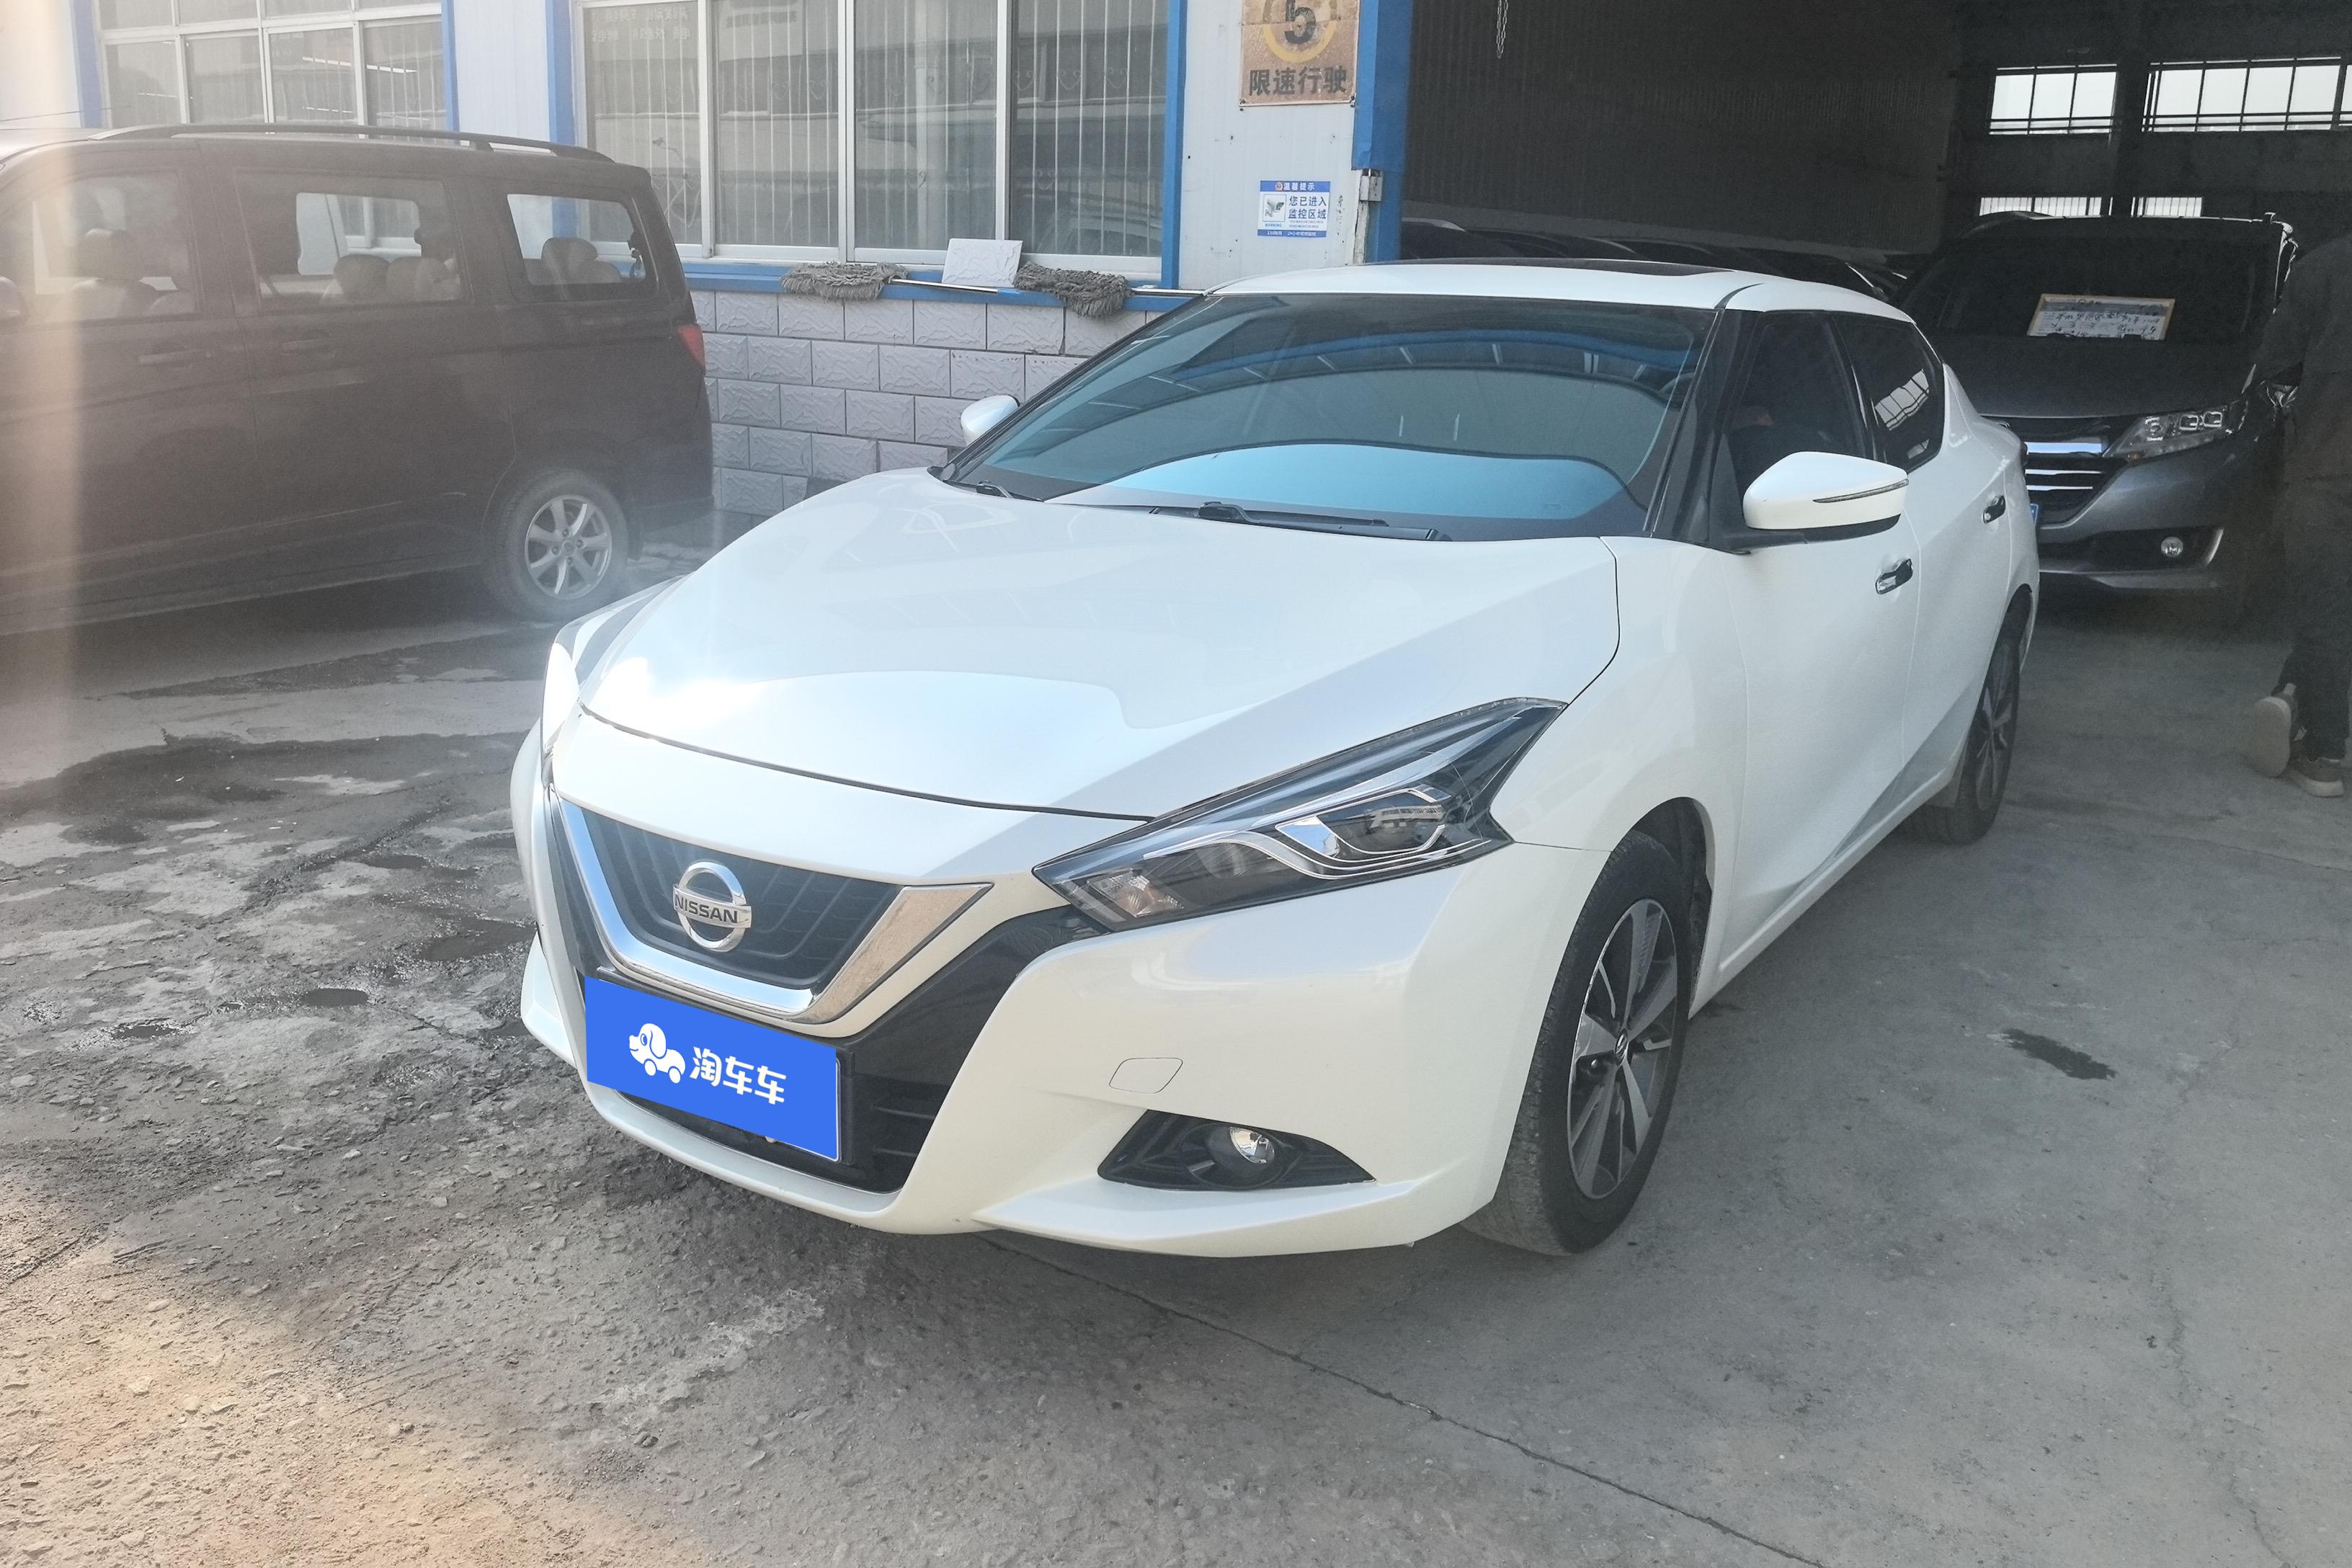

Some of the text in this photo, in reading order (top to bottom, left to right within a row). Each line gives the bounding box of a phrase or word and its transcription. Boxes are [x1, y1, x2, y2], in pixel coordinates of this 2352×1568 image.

[1285, 0, 1316, 44] 5
[1250, 66, 1347, 96] 限速行驶
[1283, 182, 1315, 191] 温馨提示
[1289, 196, 1327, 206] 您已进入
[1288, 208, 1327, 219] 监控区域
[674, 894, 738, 924] NISSAN
